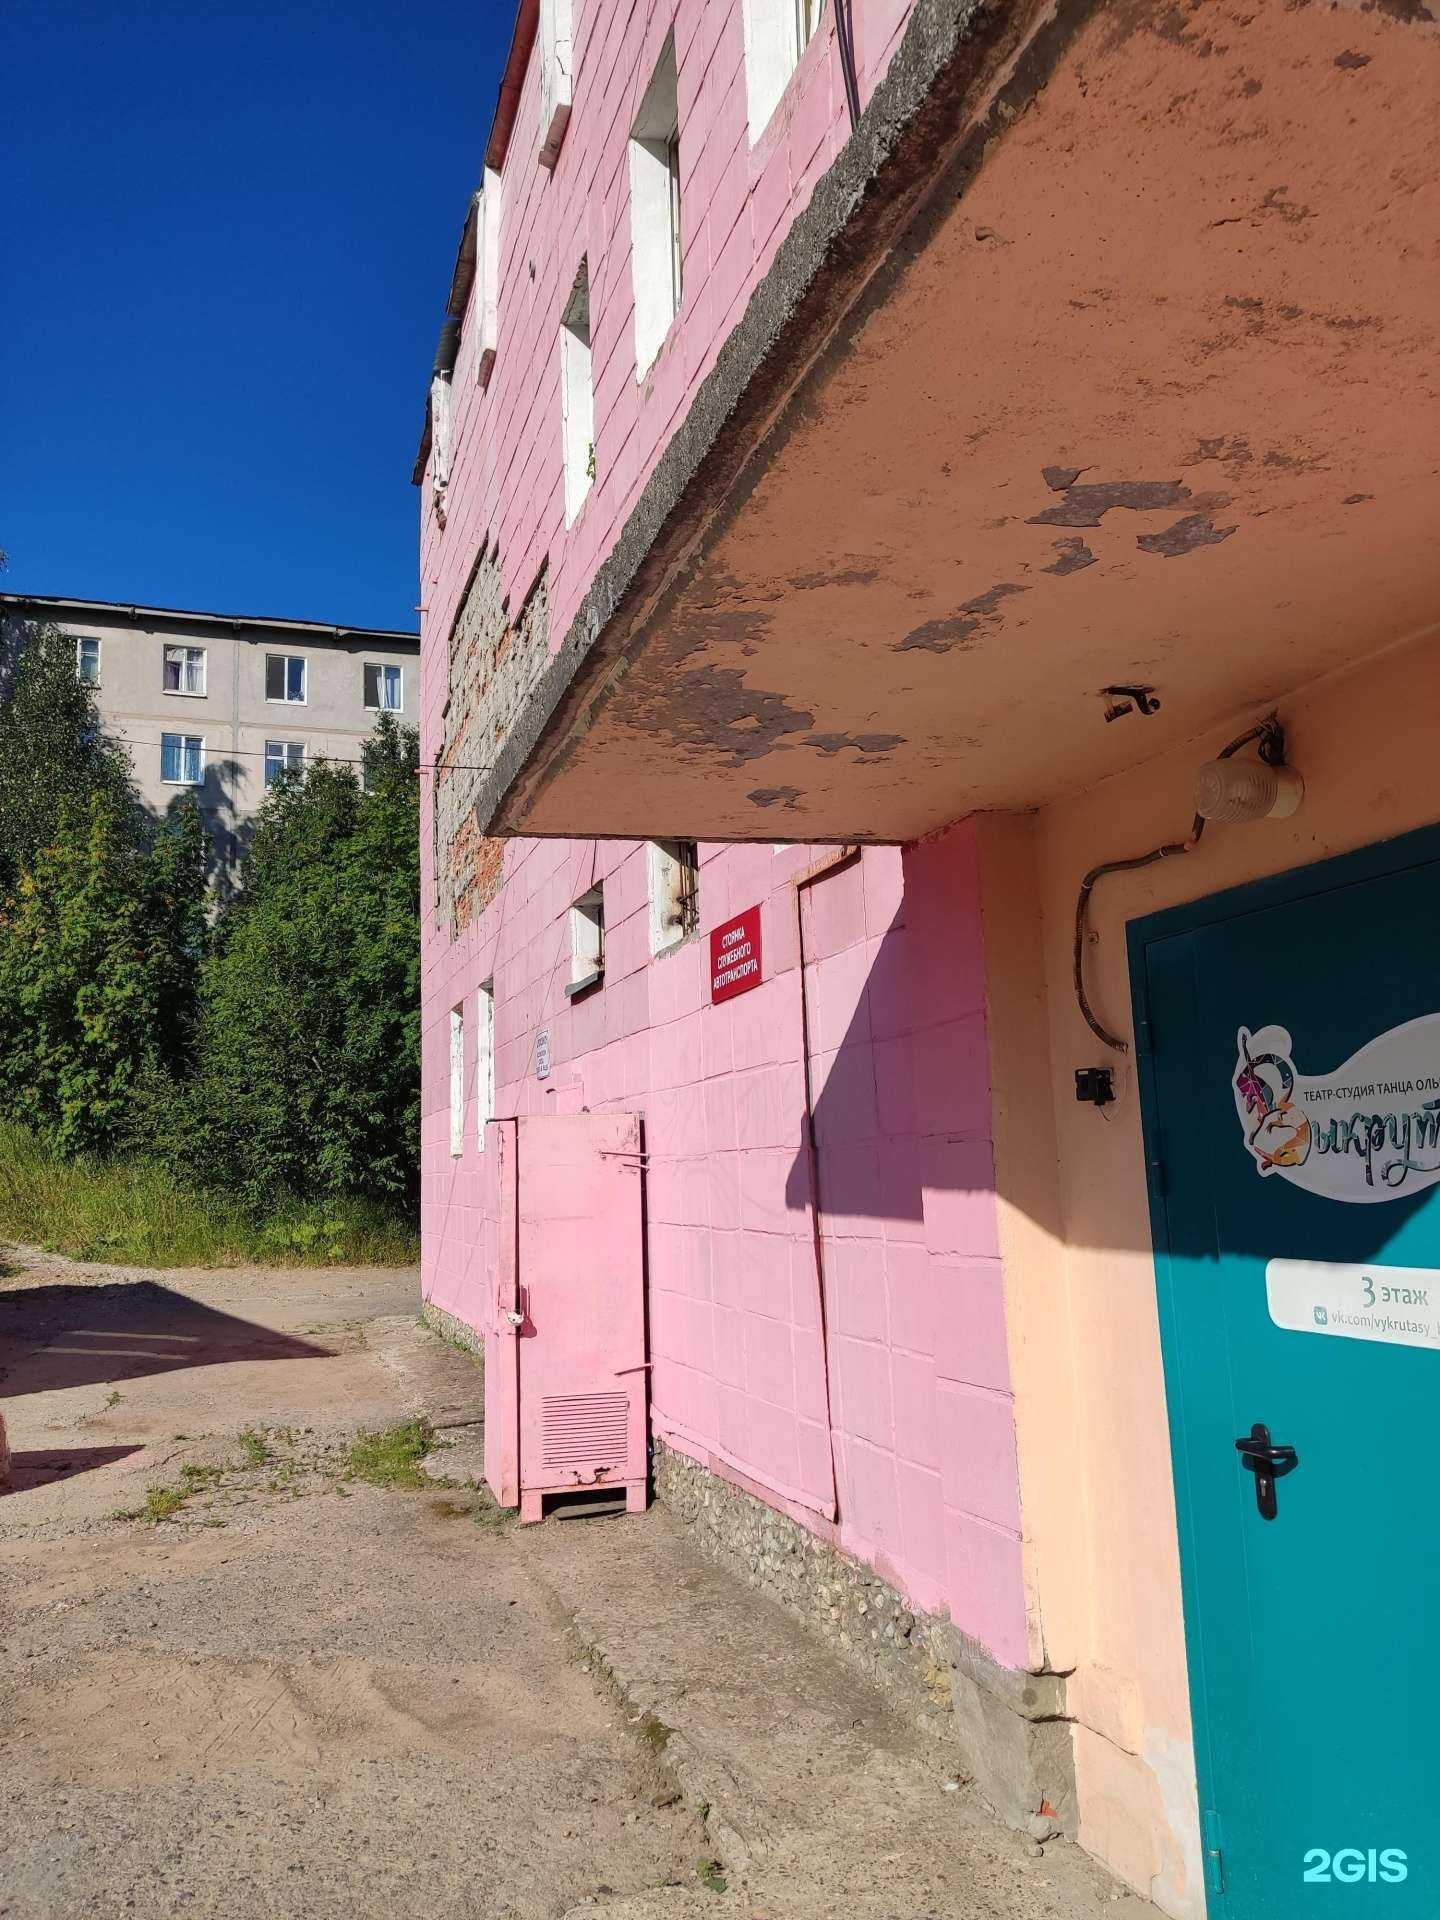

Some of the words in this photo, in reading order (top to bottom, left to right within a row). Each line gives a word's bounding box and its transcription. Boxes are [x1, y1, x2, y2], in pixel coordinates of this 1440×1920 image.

[722, 925, 745, 948] СТОЯНКА
[717, 942, 751, 969] СЛУЖЕБНОГО
[713, 958, 758, 990] АВТОТРАНСПОРТА
[1303, 1084, 1375, 1102] ТЕАТР-СТУДИЯ
[1377, 1080, 1413, 1096] ТАНЦА
[1415, 1077, 1440, 1091] ОЛЬ
[1361, 1276, 1376, 1308] 3
[1381, 1286, 1430, 1307] этаж
